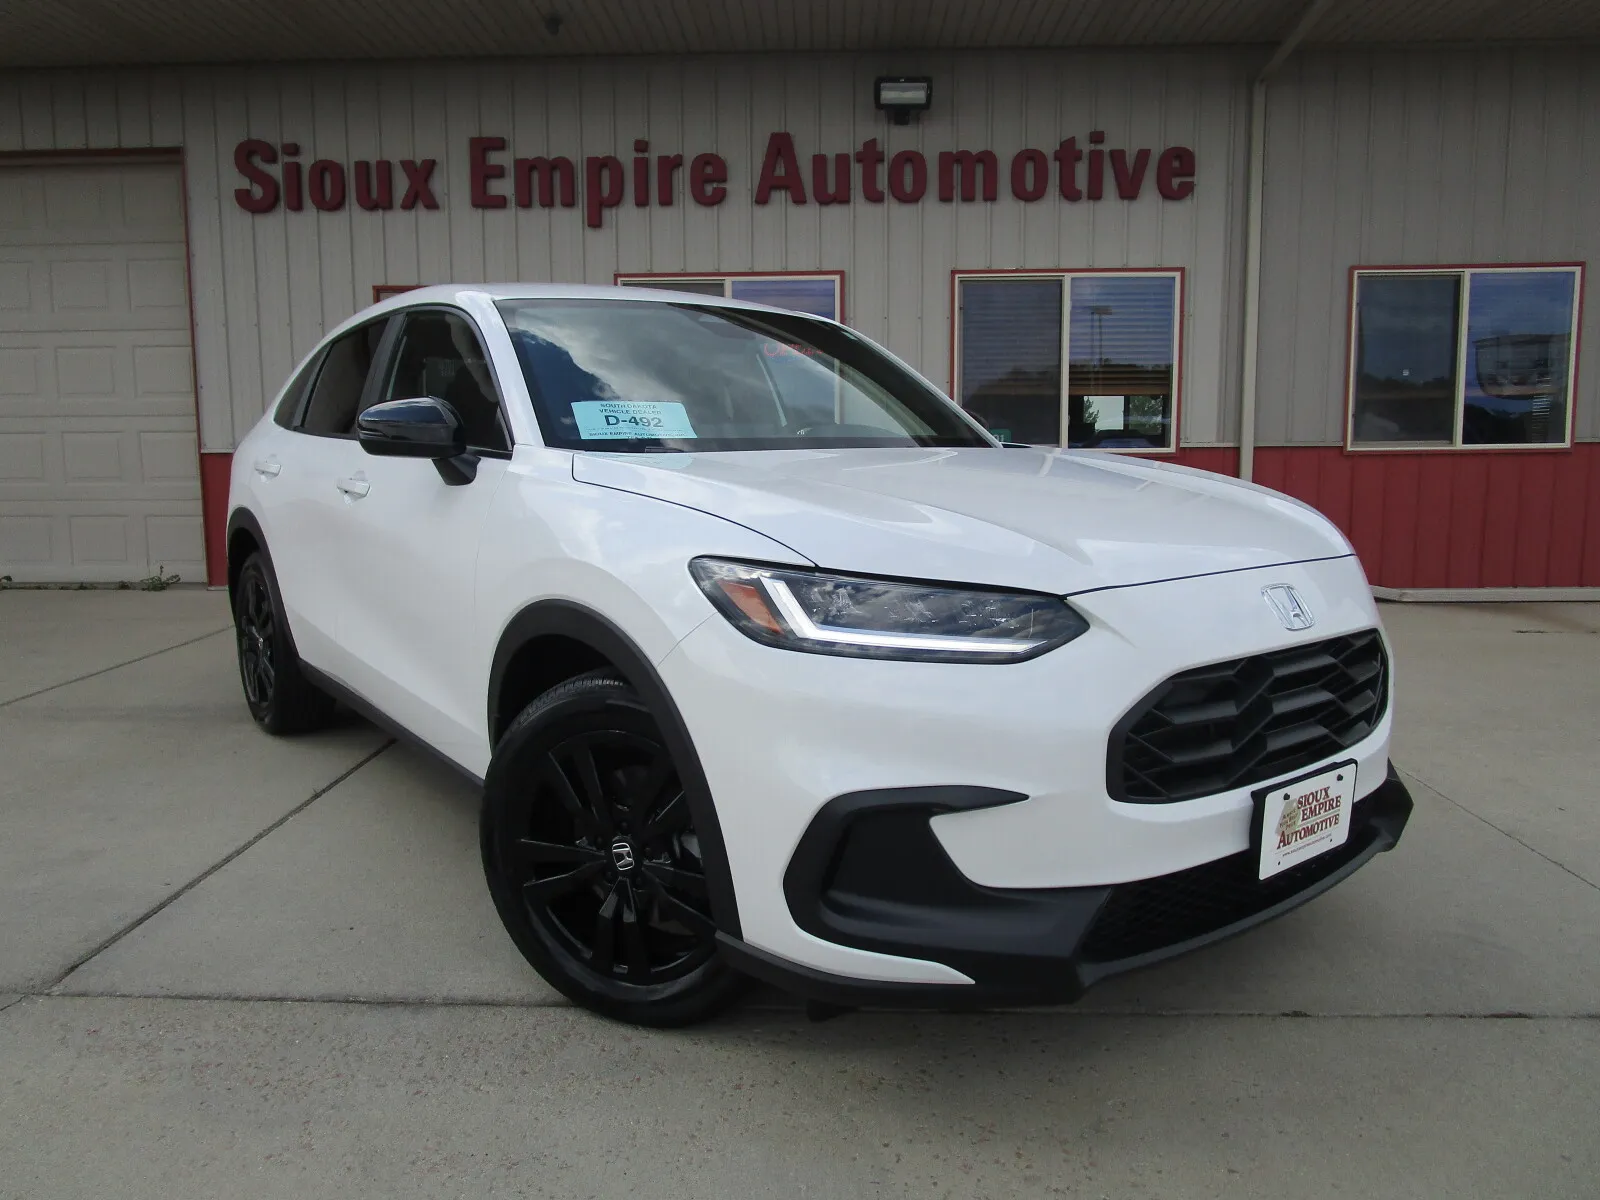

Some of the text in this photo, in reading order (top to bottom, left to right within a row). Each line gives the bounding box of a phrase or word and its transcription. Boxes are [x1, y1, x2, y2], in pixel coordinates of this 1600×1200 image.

[234, 130, 1196, 228] Sioux Empire Automotive
[604, 414, 664, 428] D-492
[1297, 786, 1331, 809] SIOUX
[1301, 795, 1342, 822] EMPIRE
[1277, 813, 1340, 849] AUTOMOTIVE
